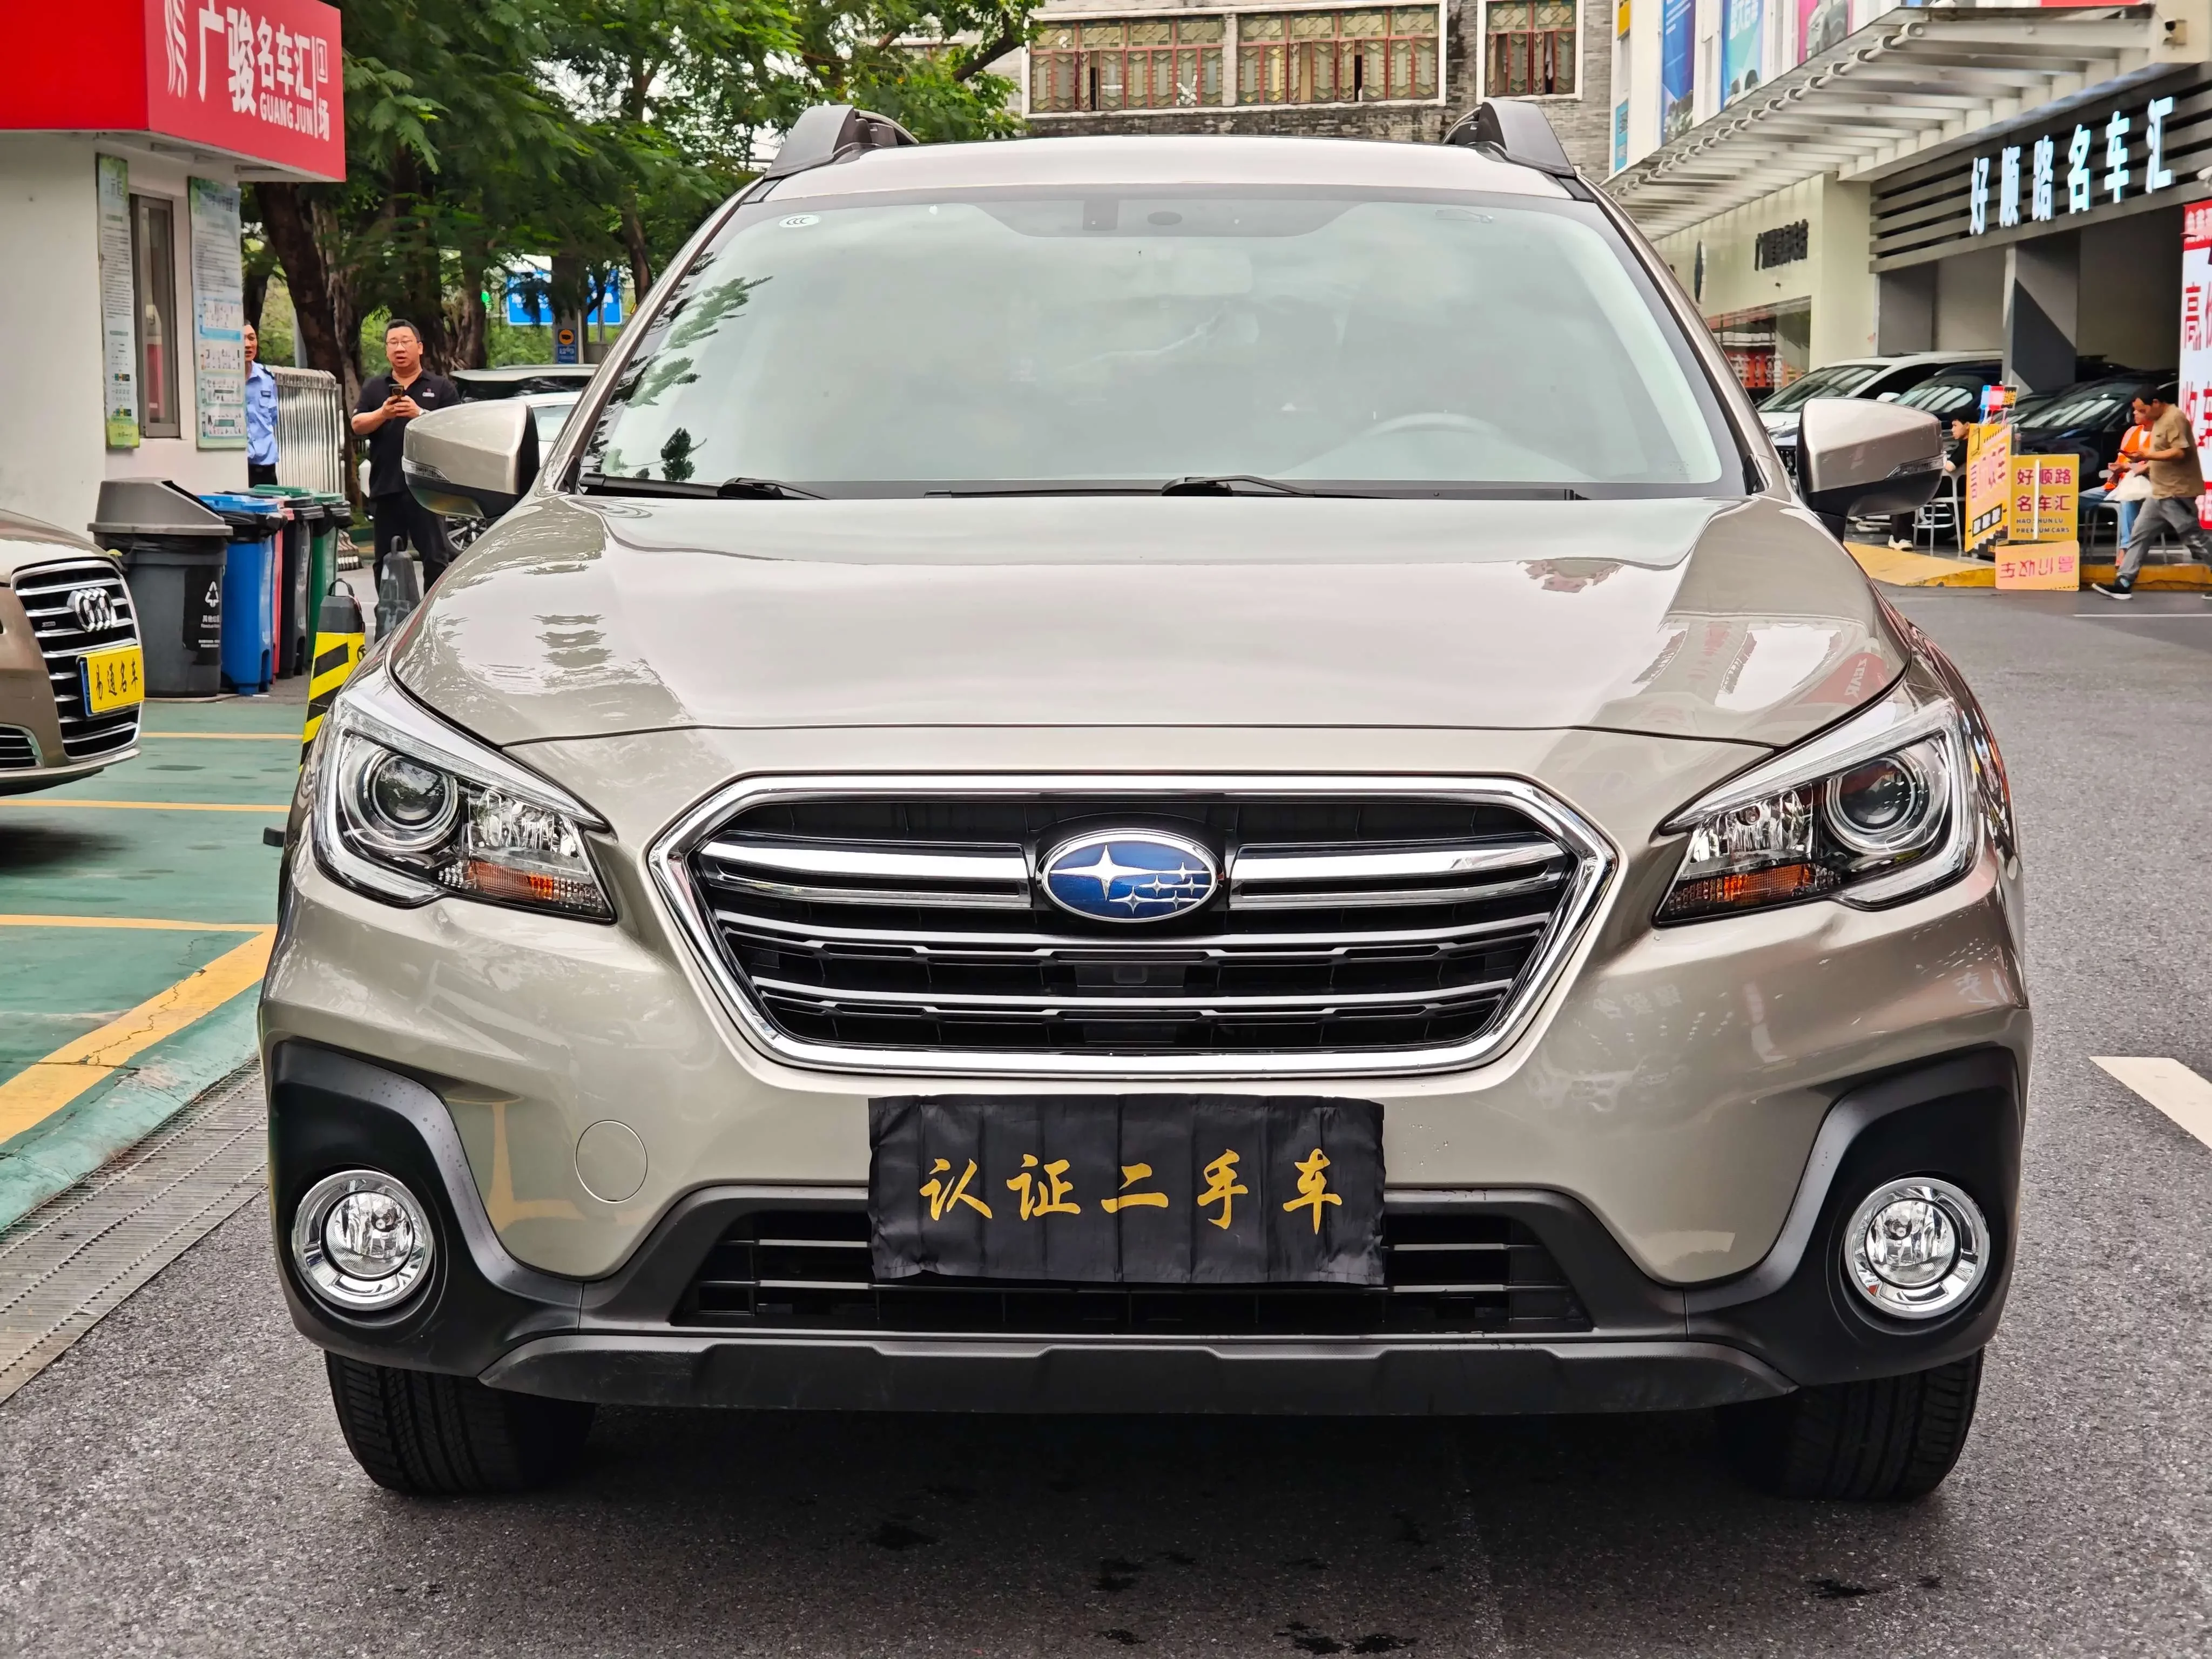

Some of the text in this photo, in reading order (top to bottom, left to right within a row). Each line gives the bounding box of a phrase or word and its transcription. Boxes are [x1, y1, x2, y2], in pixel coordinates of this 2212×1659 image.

[198, 0, 313, 117] 广骏名车汇
[260, 92, 313, 136] GUANG JUN
[1969, 96, 2174, 235] 好顺路名车汇
[2017, 469, 2071, 485] 好顺路
[2017, 495, 2071, 511] 名车汇
[919, 1148, 1343, 1235] 认证二手车
